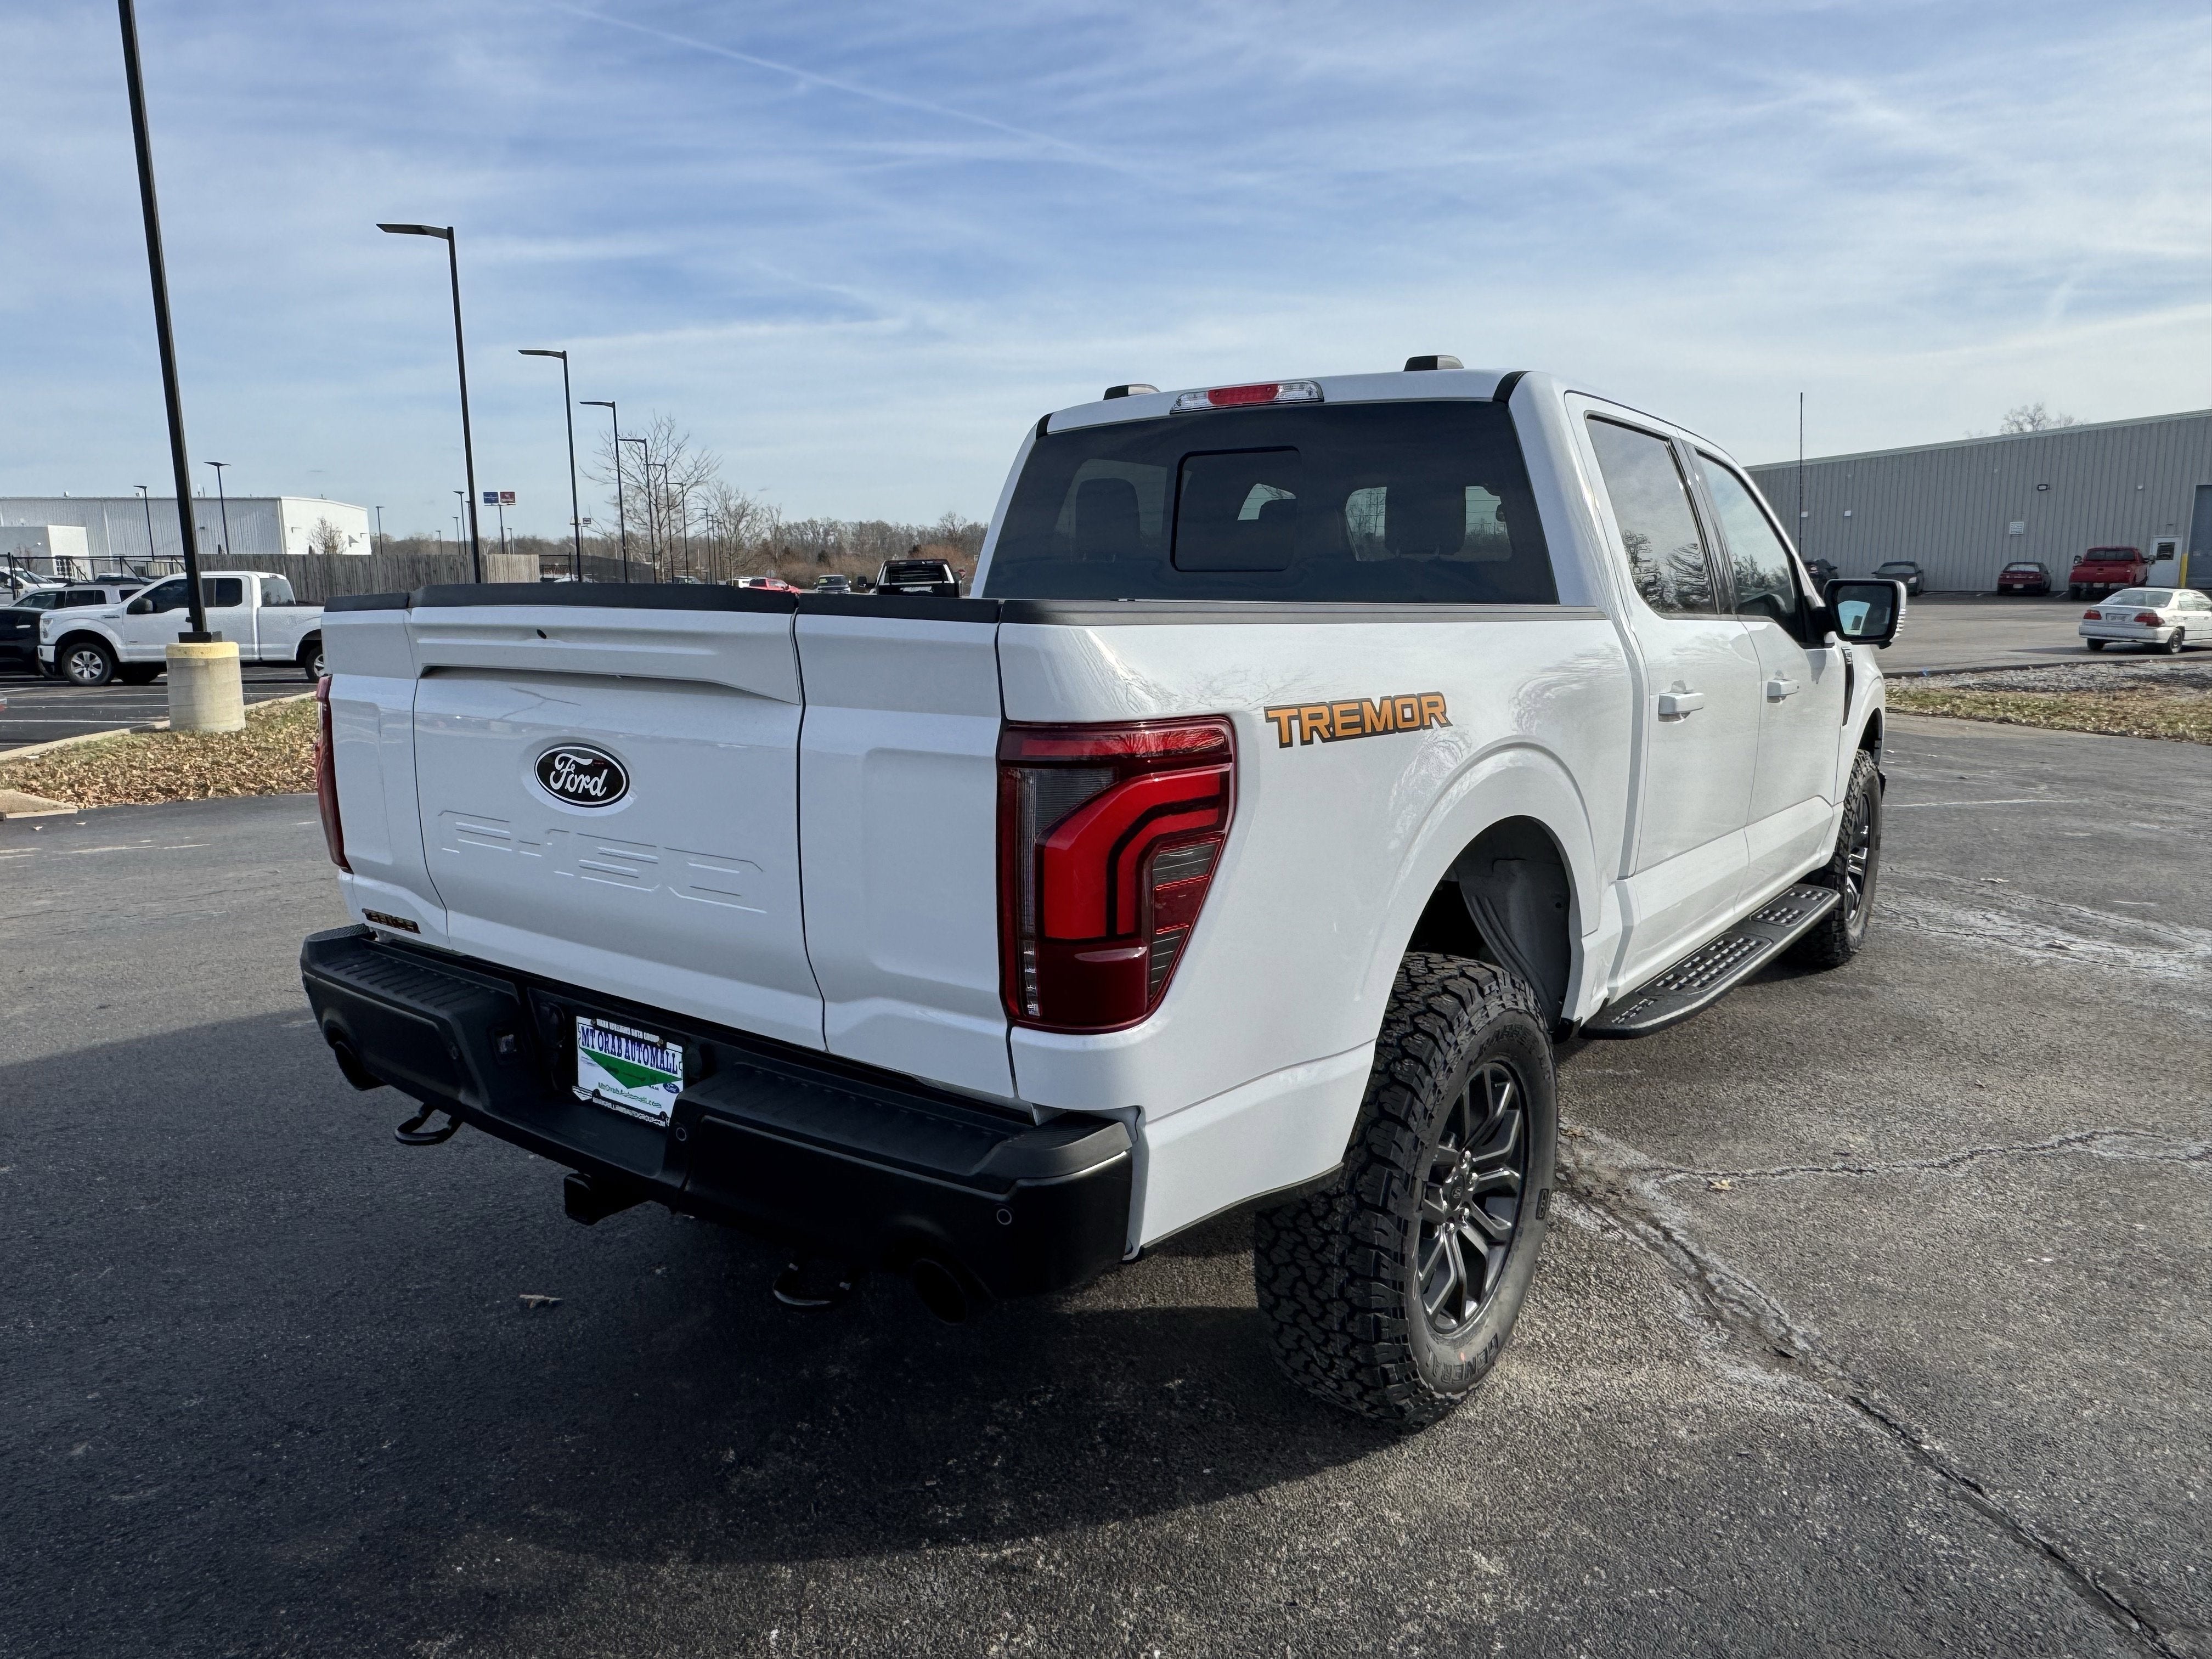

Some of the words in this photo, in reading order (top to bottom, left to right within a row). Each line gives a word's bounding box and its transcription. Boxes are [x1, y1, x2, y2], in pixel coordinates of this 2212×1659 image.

[1264, 691, 1453, 748] TREMOR
[550, 753, 608, 797] Ford
[438, 810, 767, 913] F-150
[581, 1025, 596, 1049] MT
[597, 1031, 623, 1058] ORAB
[624, 1038, 678, 1075] AUTOMALL
